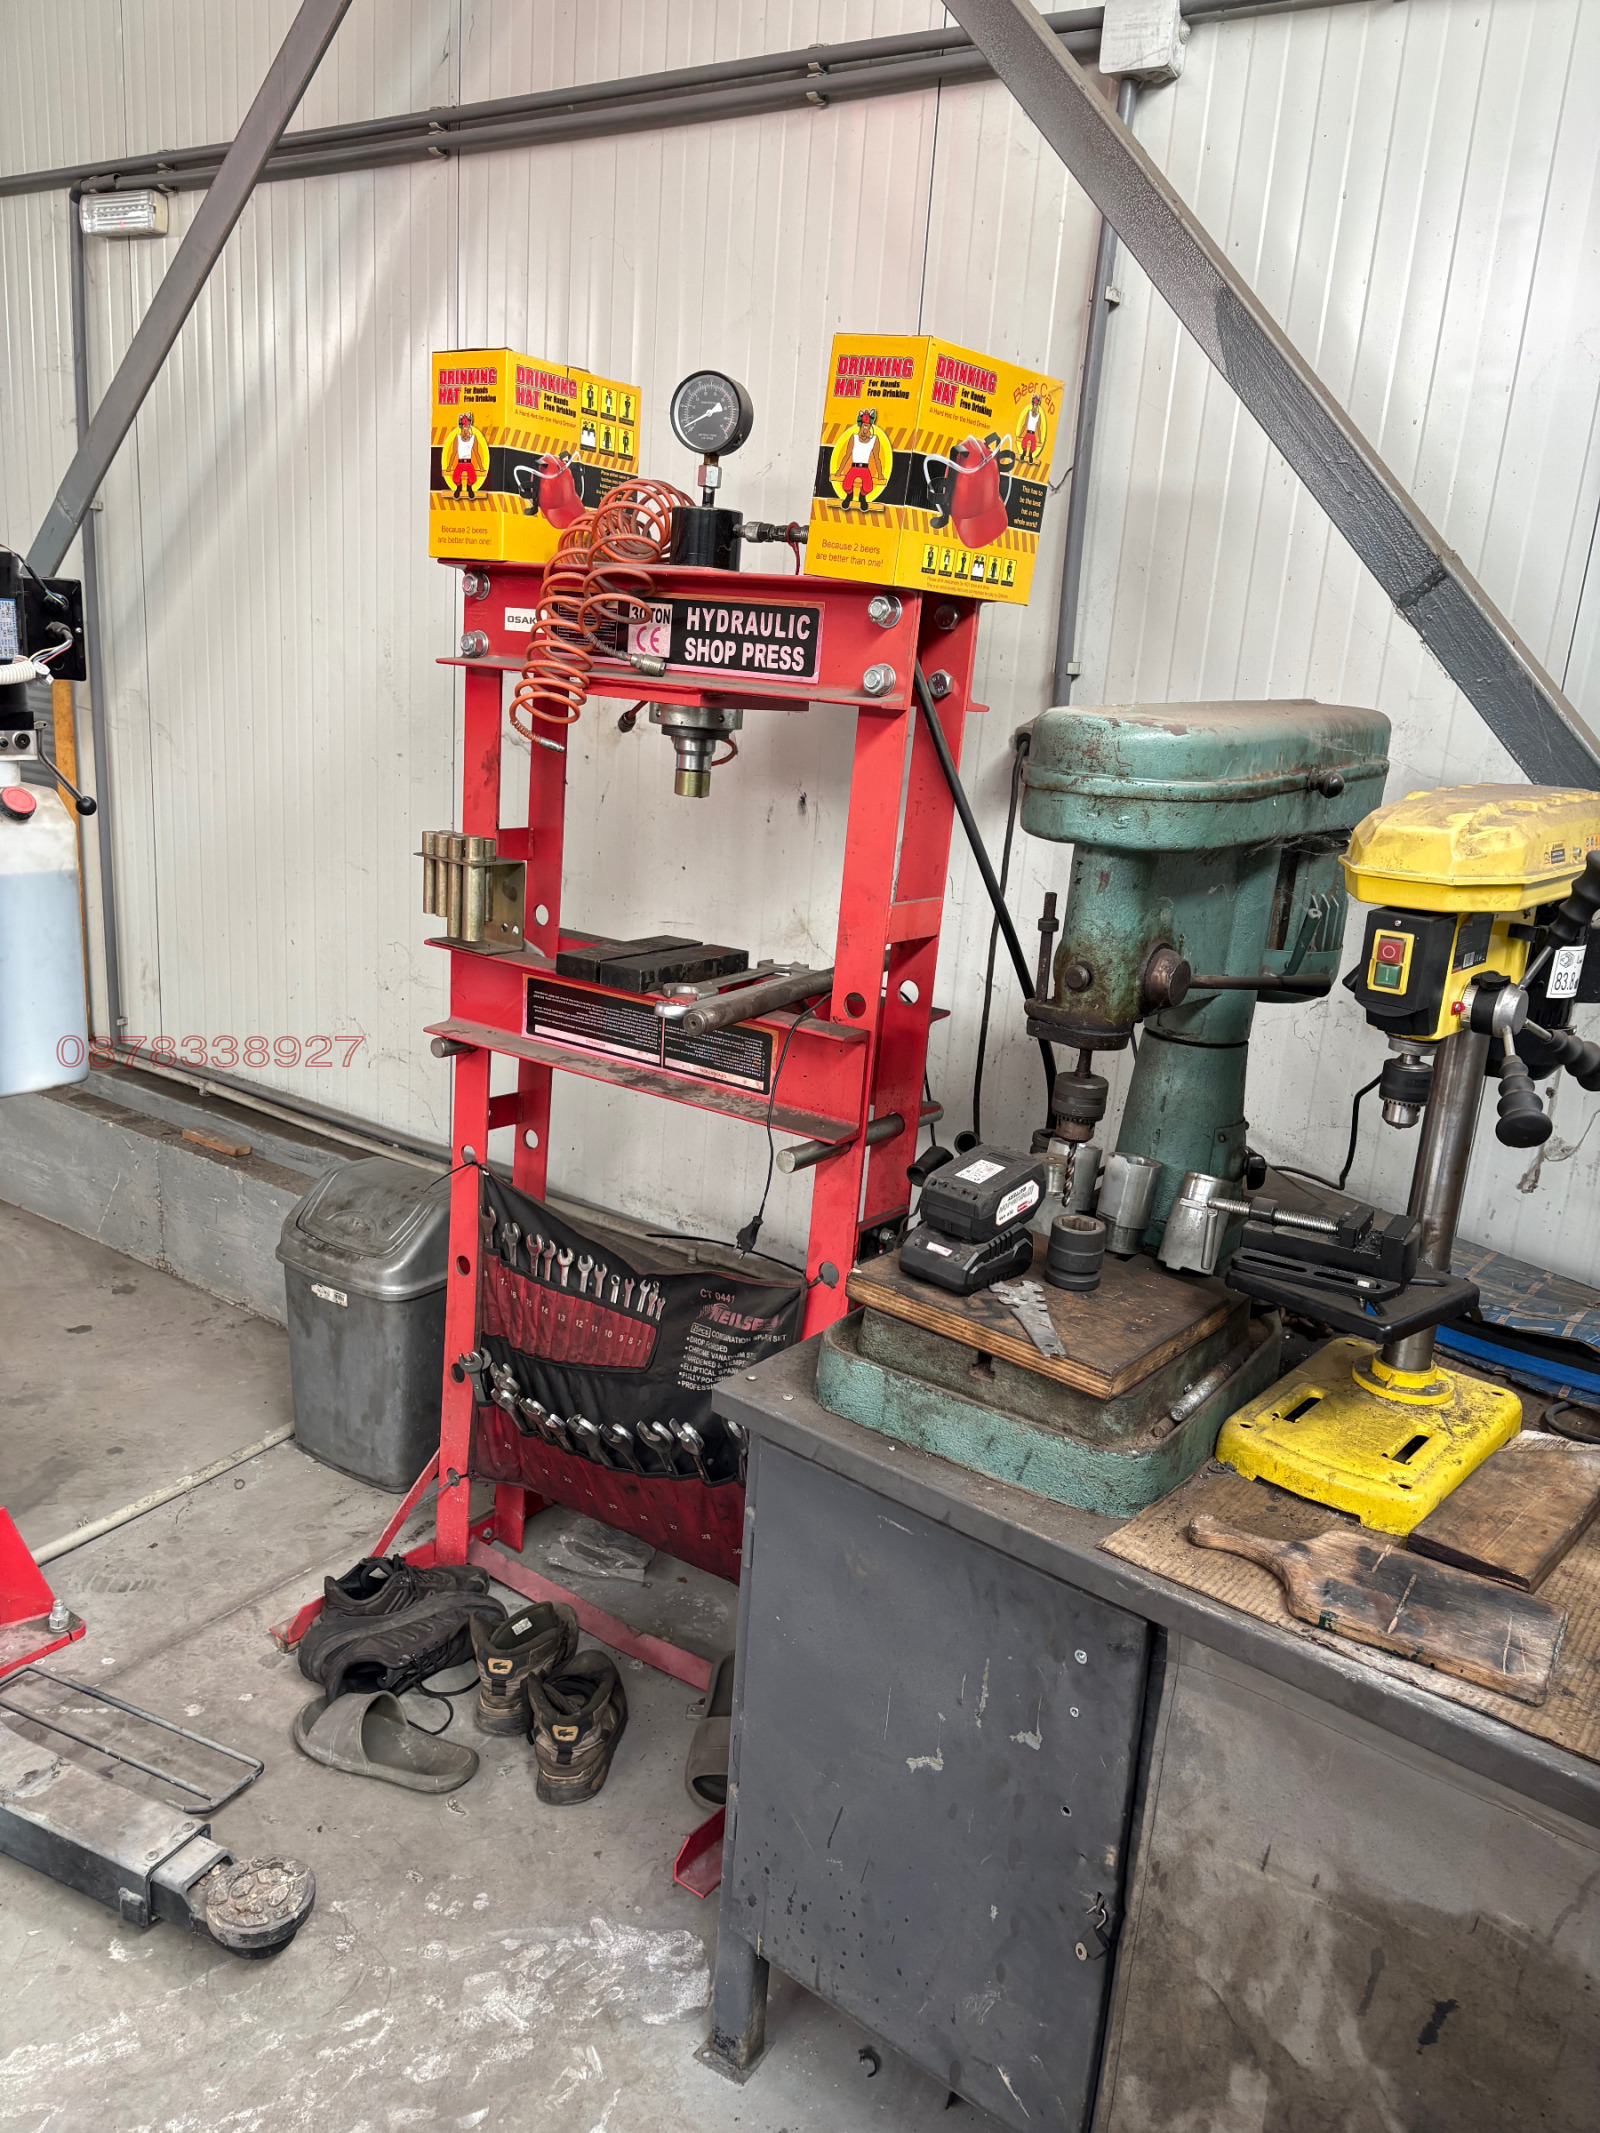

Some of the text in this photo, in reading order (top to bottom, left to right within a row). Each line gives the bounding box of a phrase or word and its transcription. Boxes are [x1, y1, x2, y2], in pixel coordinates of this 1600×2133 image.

[836, 354, 914, 379] DRINKING
[935, 353, 997, 395] DRINKING
[438, 367, 497, 386] DRINKING
[515, 364, 577, 399] DRINKING
[868, 379, 900, 388] For Hands
[438, 386, 461, 404] HAT
[833, 377, 866, 398] HAT
[867, 388, 910, 399] Free Drinking
[931, 378, 959, 408] HAT
[475, 395, 496, 403] Drinking
[515, 385, 541, 410] HAT
[961, 388, 986, 404] For Hands
[1013, 382, 1055, 415] Beer Cap
[960, 399, 993, 418] Free Drinking
[442, 525, 465, 533] Because
[466, 526, 471, 534] 2
[447, 536, 464, 544] better
[822, 539, 880, 554] Because 2 beers
[816, 552, 884, 567] are better than one!
[507, 615, 537, 624] OSAK
[649, 608, 671, 625] TON
[686, 606, 811, 640] HYDRAULIC
[684, 637, 805, 672] SHOP PRESS
[700, 1288, 735, 1303] CT 0441
[541, 1305, 549, 1314] 14
[557, 1313, 566, 1322] 13
[575, 1319, 584, 1328] 12
[591, 1324, 598, 1333] 11
[604, 1329, 613, 1338] 10
[619, 1334, 624, 1342] 9
[628, 1337, 633, 1345] 8
[690, 1335, 728, 1353] DROP FORGED
[688, 1345, 710, 1357] CHROME
[681, 1371, 701, 1381] FULLY
[683, 1363, 716, 1377] ELLIPTICAL
